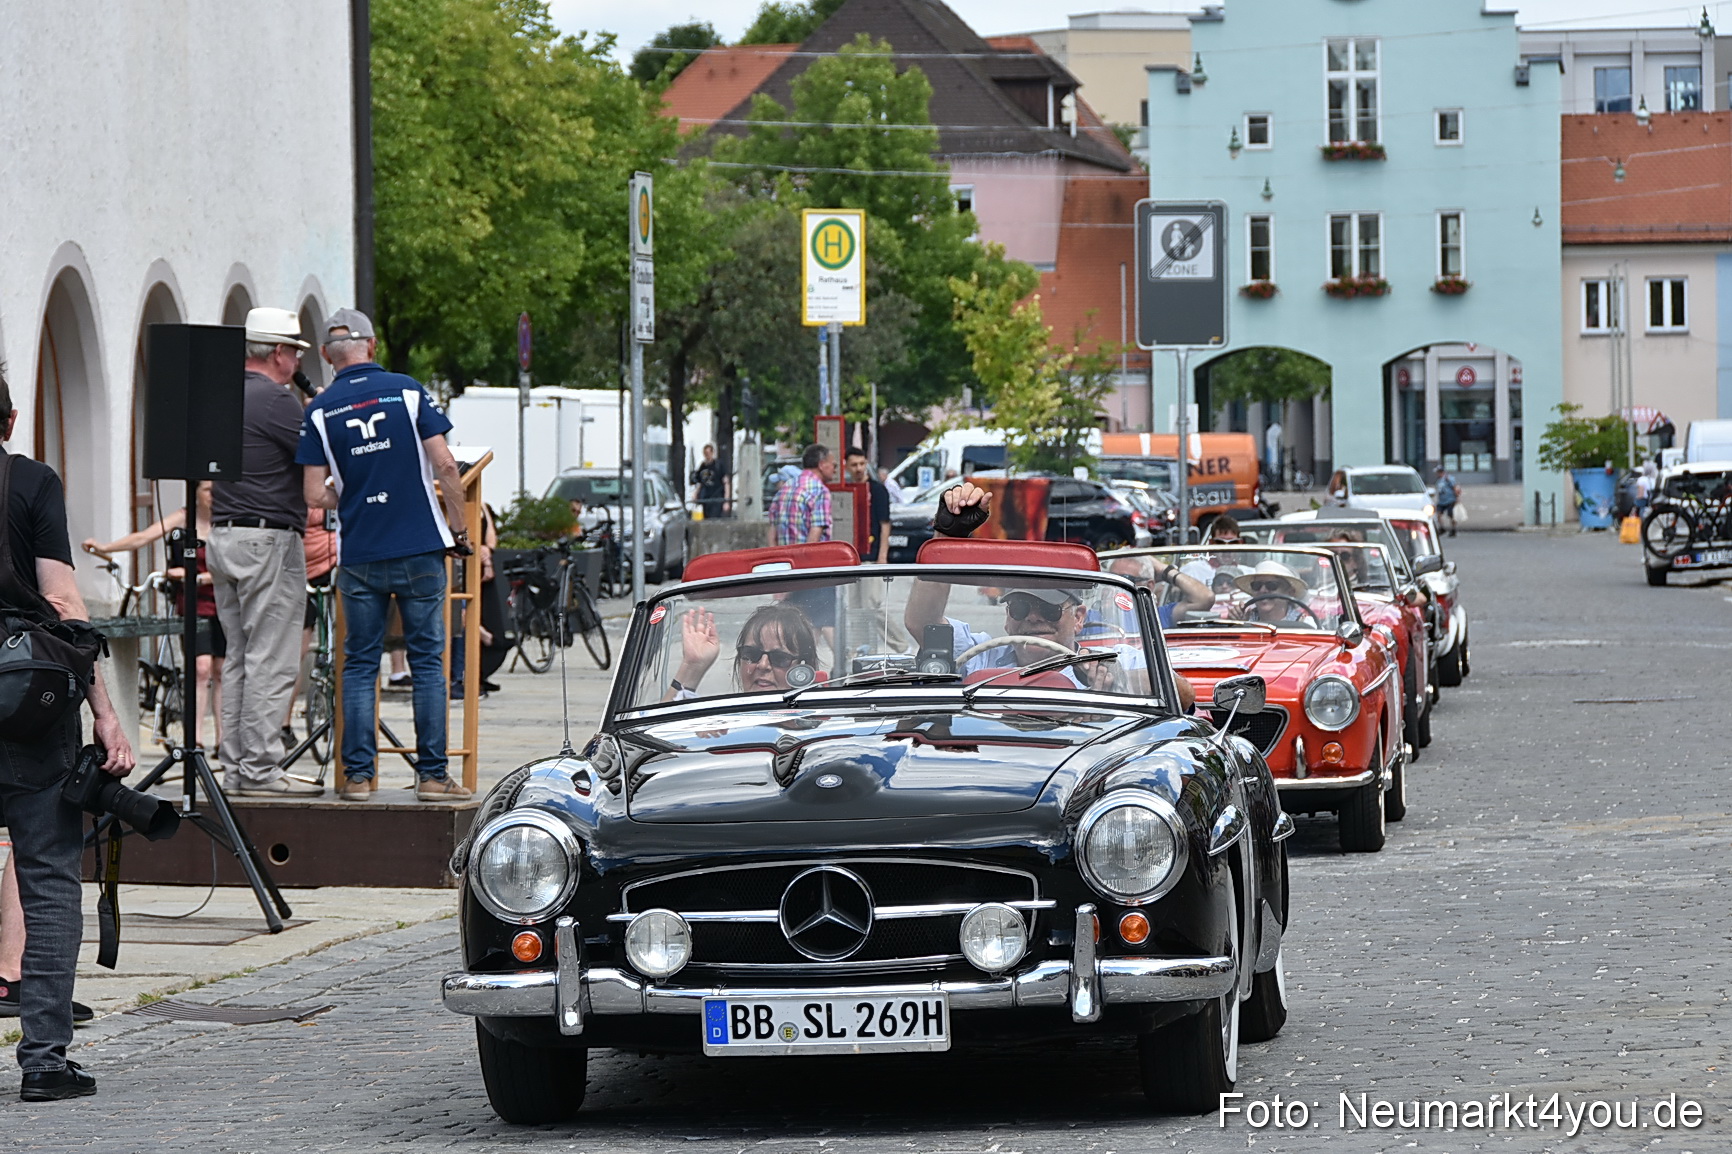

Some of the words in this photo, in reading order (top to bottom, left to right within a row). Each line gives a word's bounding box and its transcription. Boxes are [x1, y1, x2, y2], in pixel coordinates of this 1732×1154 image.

[1166, 264, 1198, 275] ZONE
[350, 437, 391, 456] randstad
[731, 1004, 775, 1040] BB
[804, 1003, 847, 1039] SL
[856, 1000, 944, 1038] 269H
[713, 1027, 722, 1038] D
